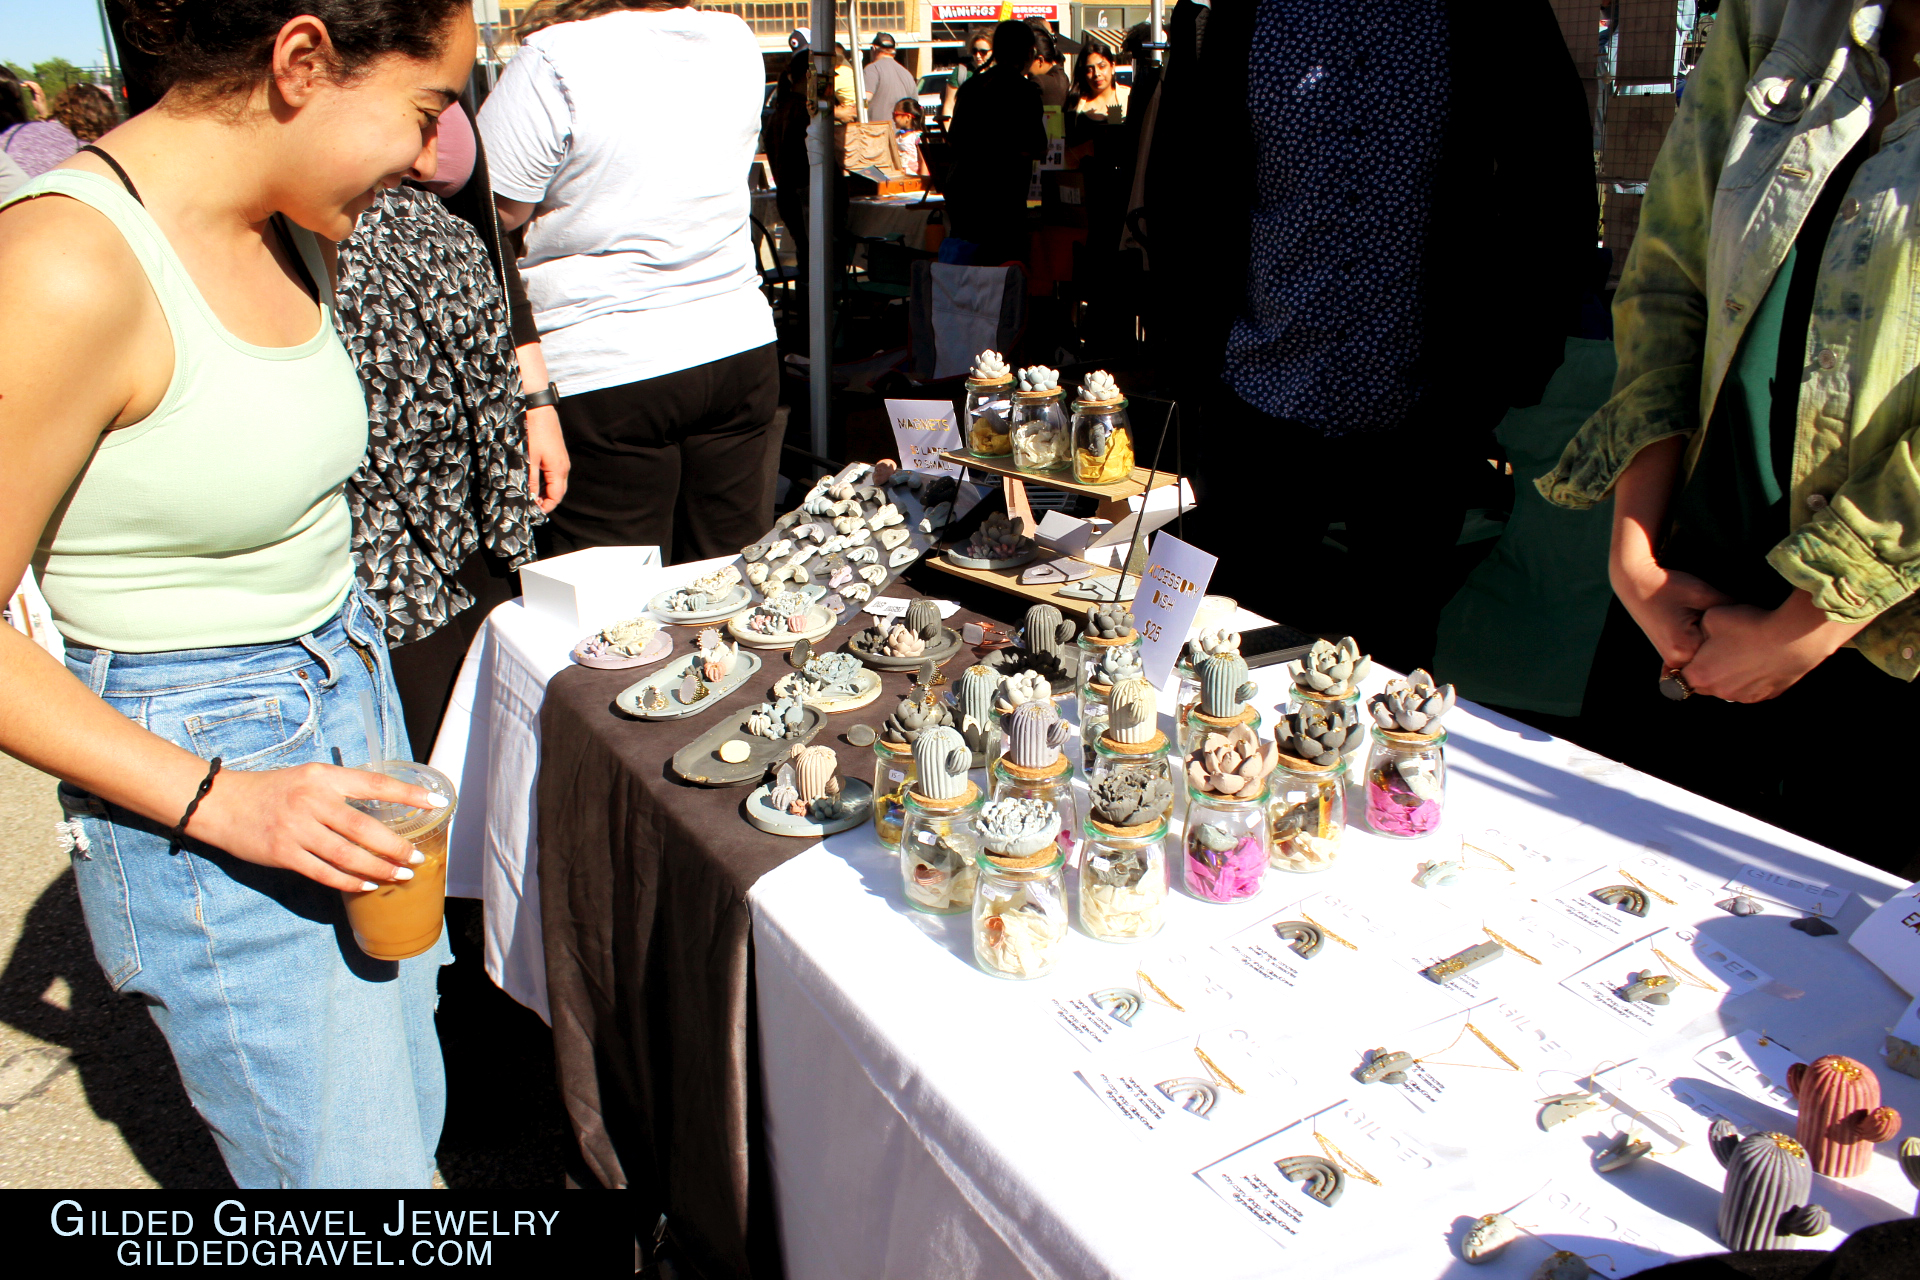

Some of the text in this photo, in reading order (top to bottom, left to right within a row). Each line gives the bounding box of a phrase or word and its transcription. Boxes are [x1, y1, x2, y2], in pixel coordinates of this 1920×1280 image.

[1012, 6, 1053, 14] BRICKS
[897, 417, 950, 432] MAGNETS
[913, 459, 953, 471] $2 SMALL
[1147, 562, 1202, 599] ACCESSORY
[1151, 589, 1176, 612] DISH
[1142, 619, 1162, 642] $25
[1747, 869, 1840, 899] GILDED
[1675, 928, 1759, 982] GILDED
[1344, 1107, 1433, 1170] GILDED
[1548, 1191, 1661, 1257] GILDED
